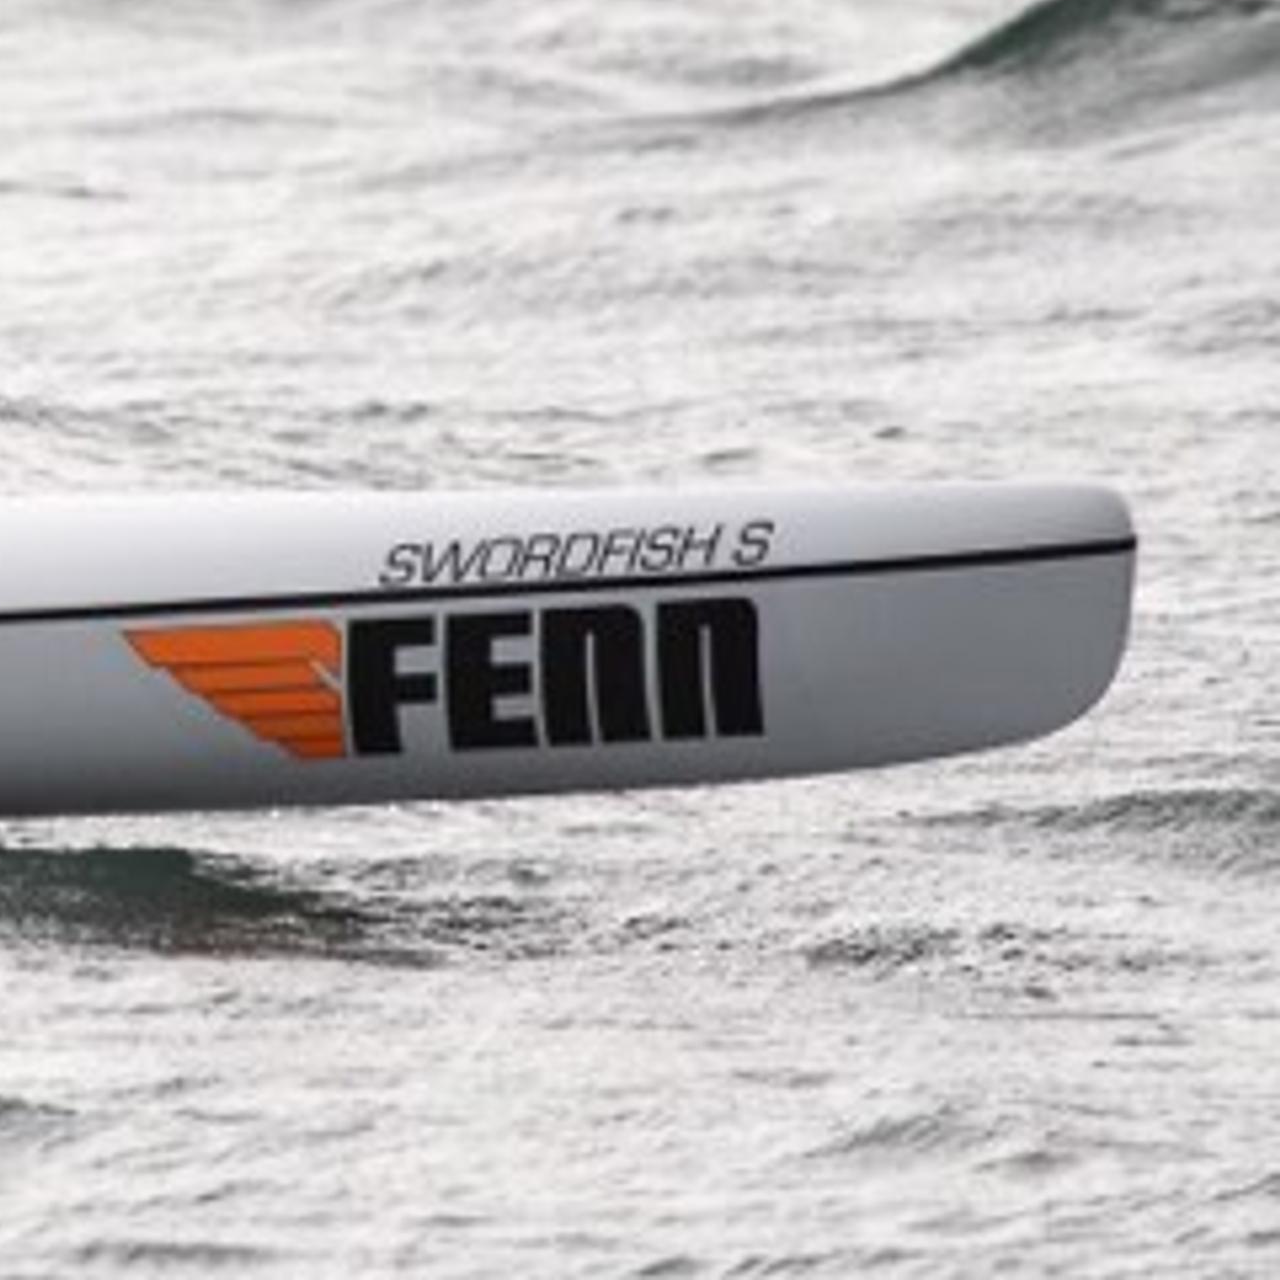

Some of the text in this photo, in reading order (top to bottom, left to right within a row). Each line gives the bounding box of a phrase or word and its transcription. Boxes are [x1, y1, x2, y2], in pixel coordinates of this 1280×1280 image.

[379, 521, 775, 584] SWORDFISH S
[348, 598, 764, 755] FENN
